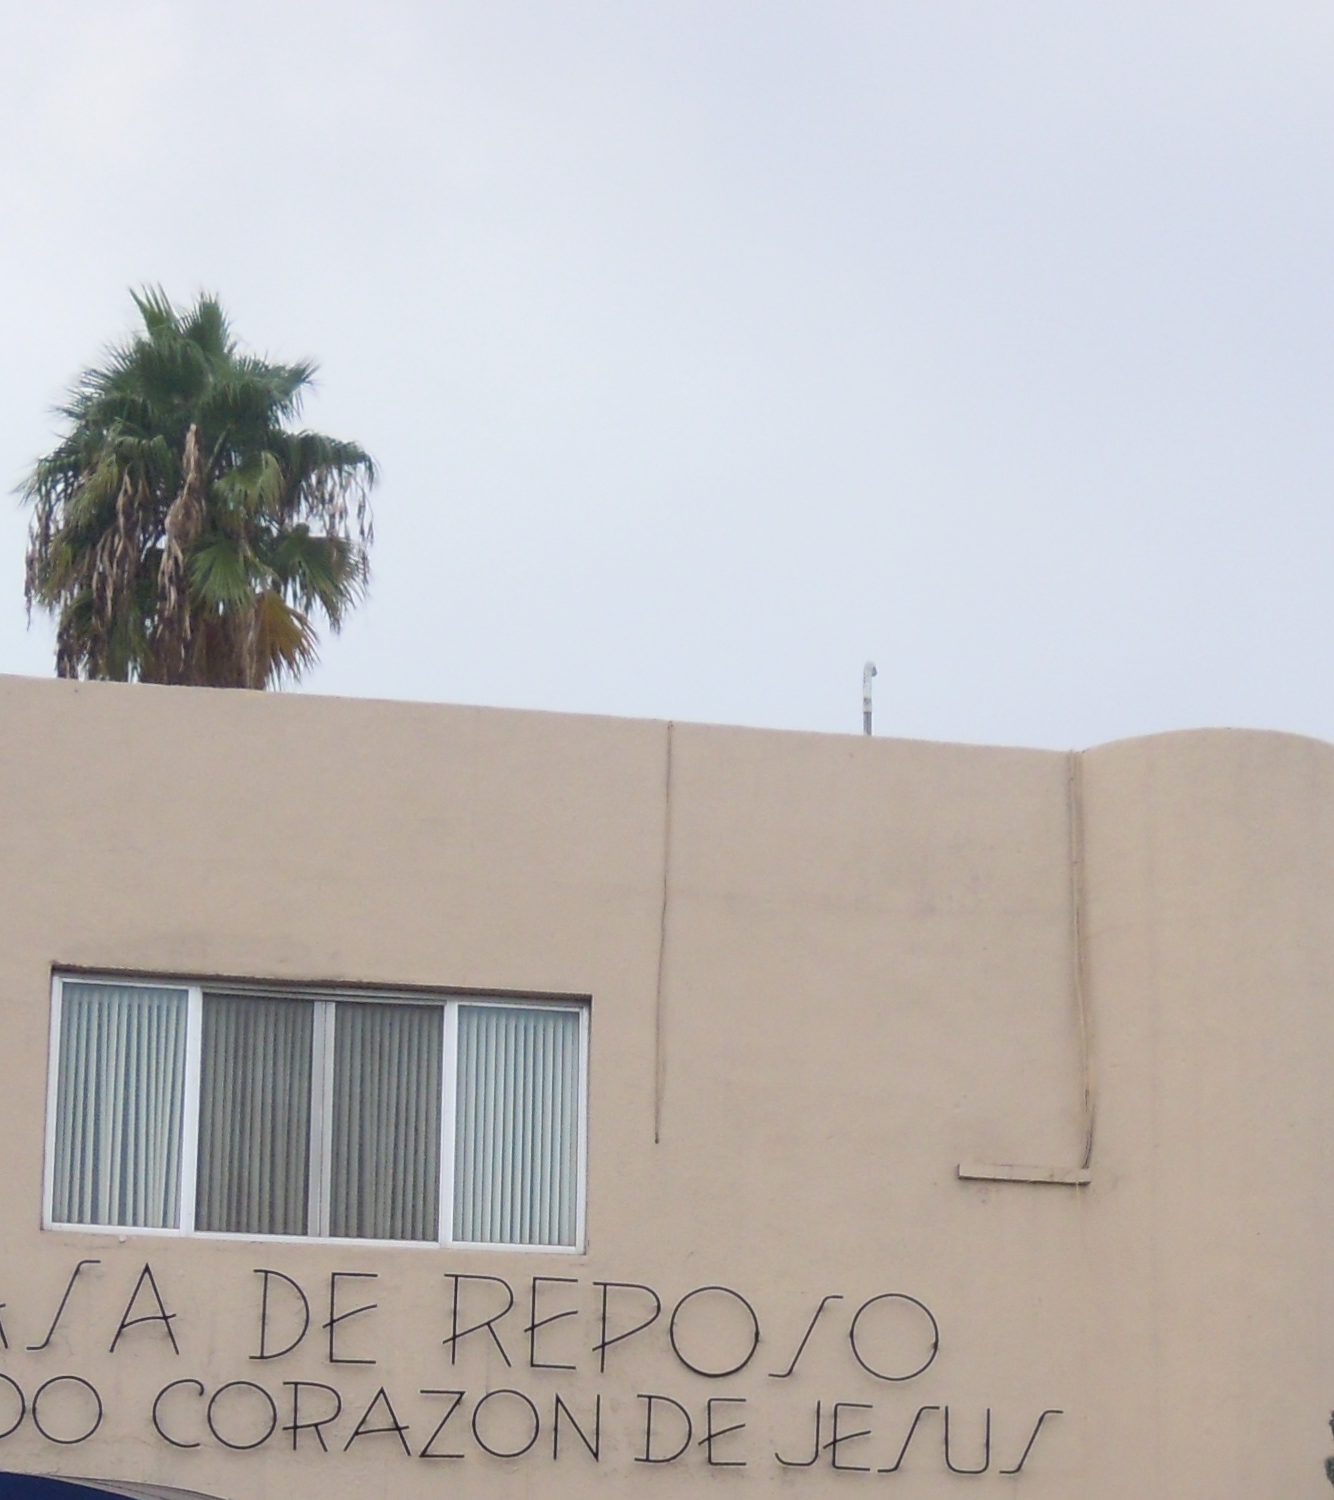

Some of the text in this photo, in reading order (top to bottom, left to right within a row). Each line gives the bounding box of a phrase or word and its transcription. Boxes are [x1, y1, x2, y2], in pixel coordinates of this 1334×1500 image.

[248, 1268, 379, 1365] DE
[442, 1273, 939, 1381] REPOSO
[152, 1378, 601, 1463] CORAZON
[633, 1394, 748, 1467] DE
[774, 1400, 1064, 1475] JESUS
